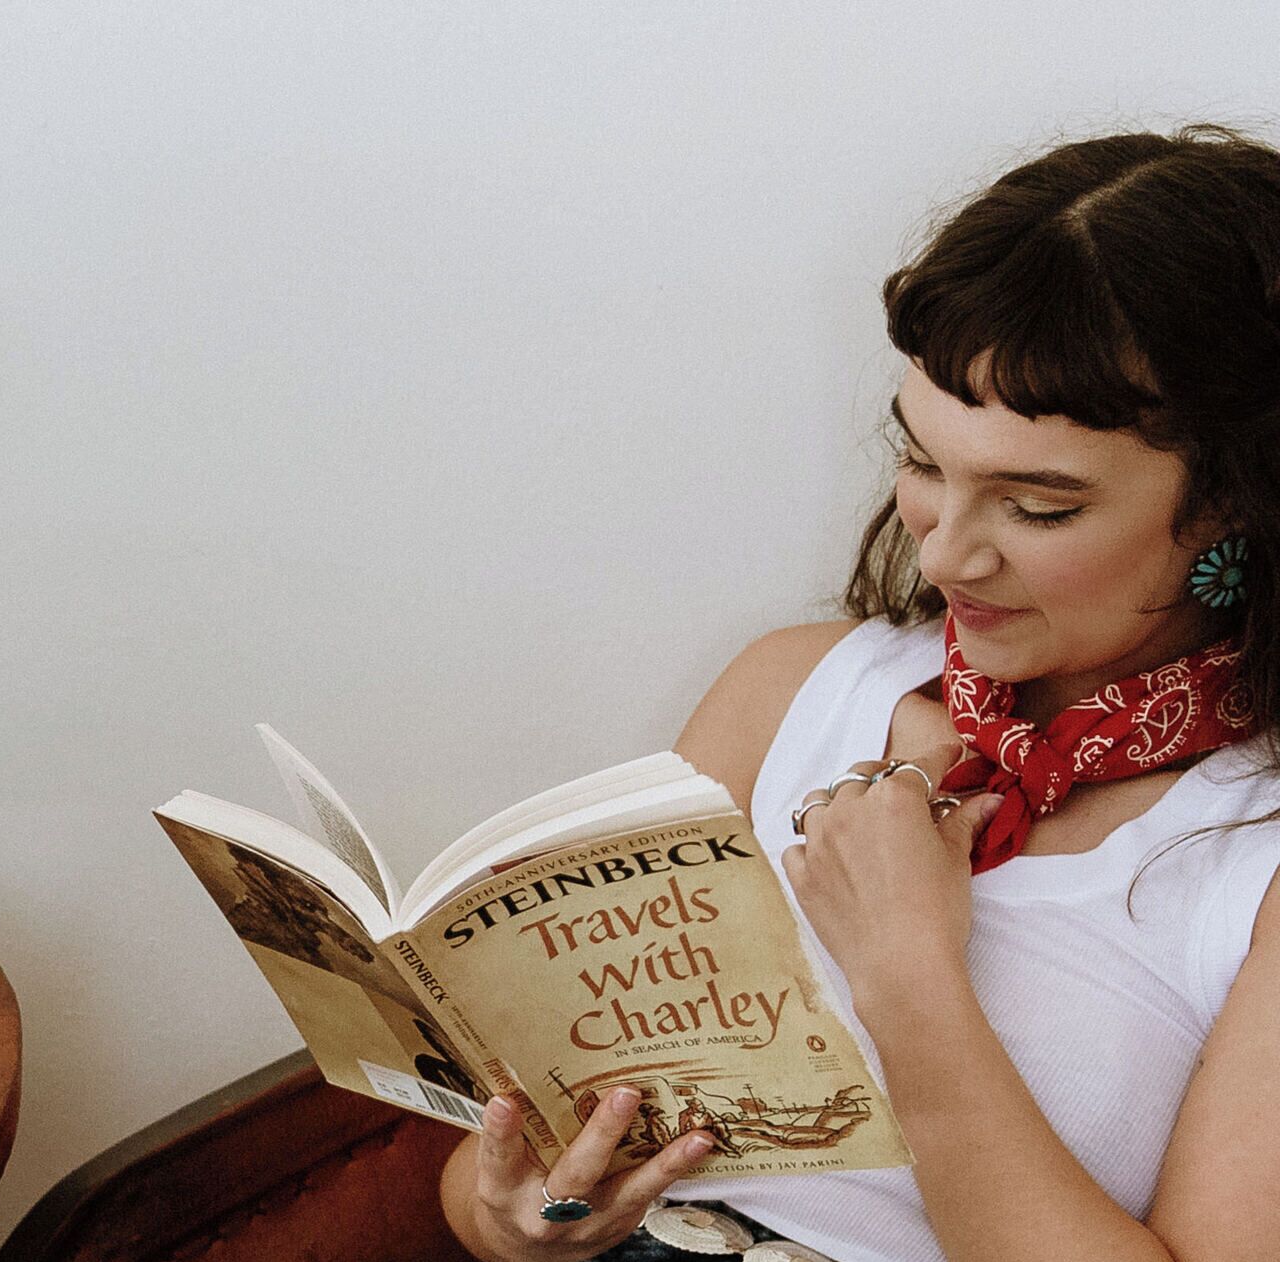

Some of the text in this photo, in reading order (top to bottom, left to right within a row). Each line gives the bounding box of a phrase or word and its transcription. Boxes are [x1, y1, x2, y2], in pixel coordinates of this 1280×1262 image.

[628, 826, 704, 848] EDITION
[443, 833, 756, 949] STEINBECK
[518, 875, 720, 960] Travels
[394, 940, 449, 1004] STEINBECK
[578, 932, 721, 1000] with
[570, 979, 790, 1051] Charley
[615, 1034, 763, 1058] IN SEARCH OF AMERICA
[689, 1158, 845, 1175] ODUCTION BY JAY PARINI
